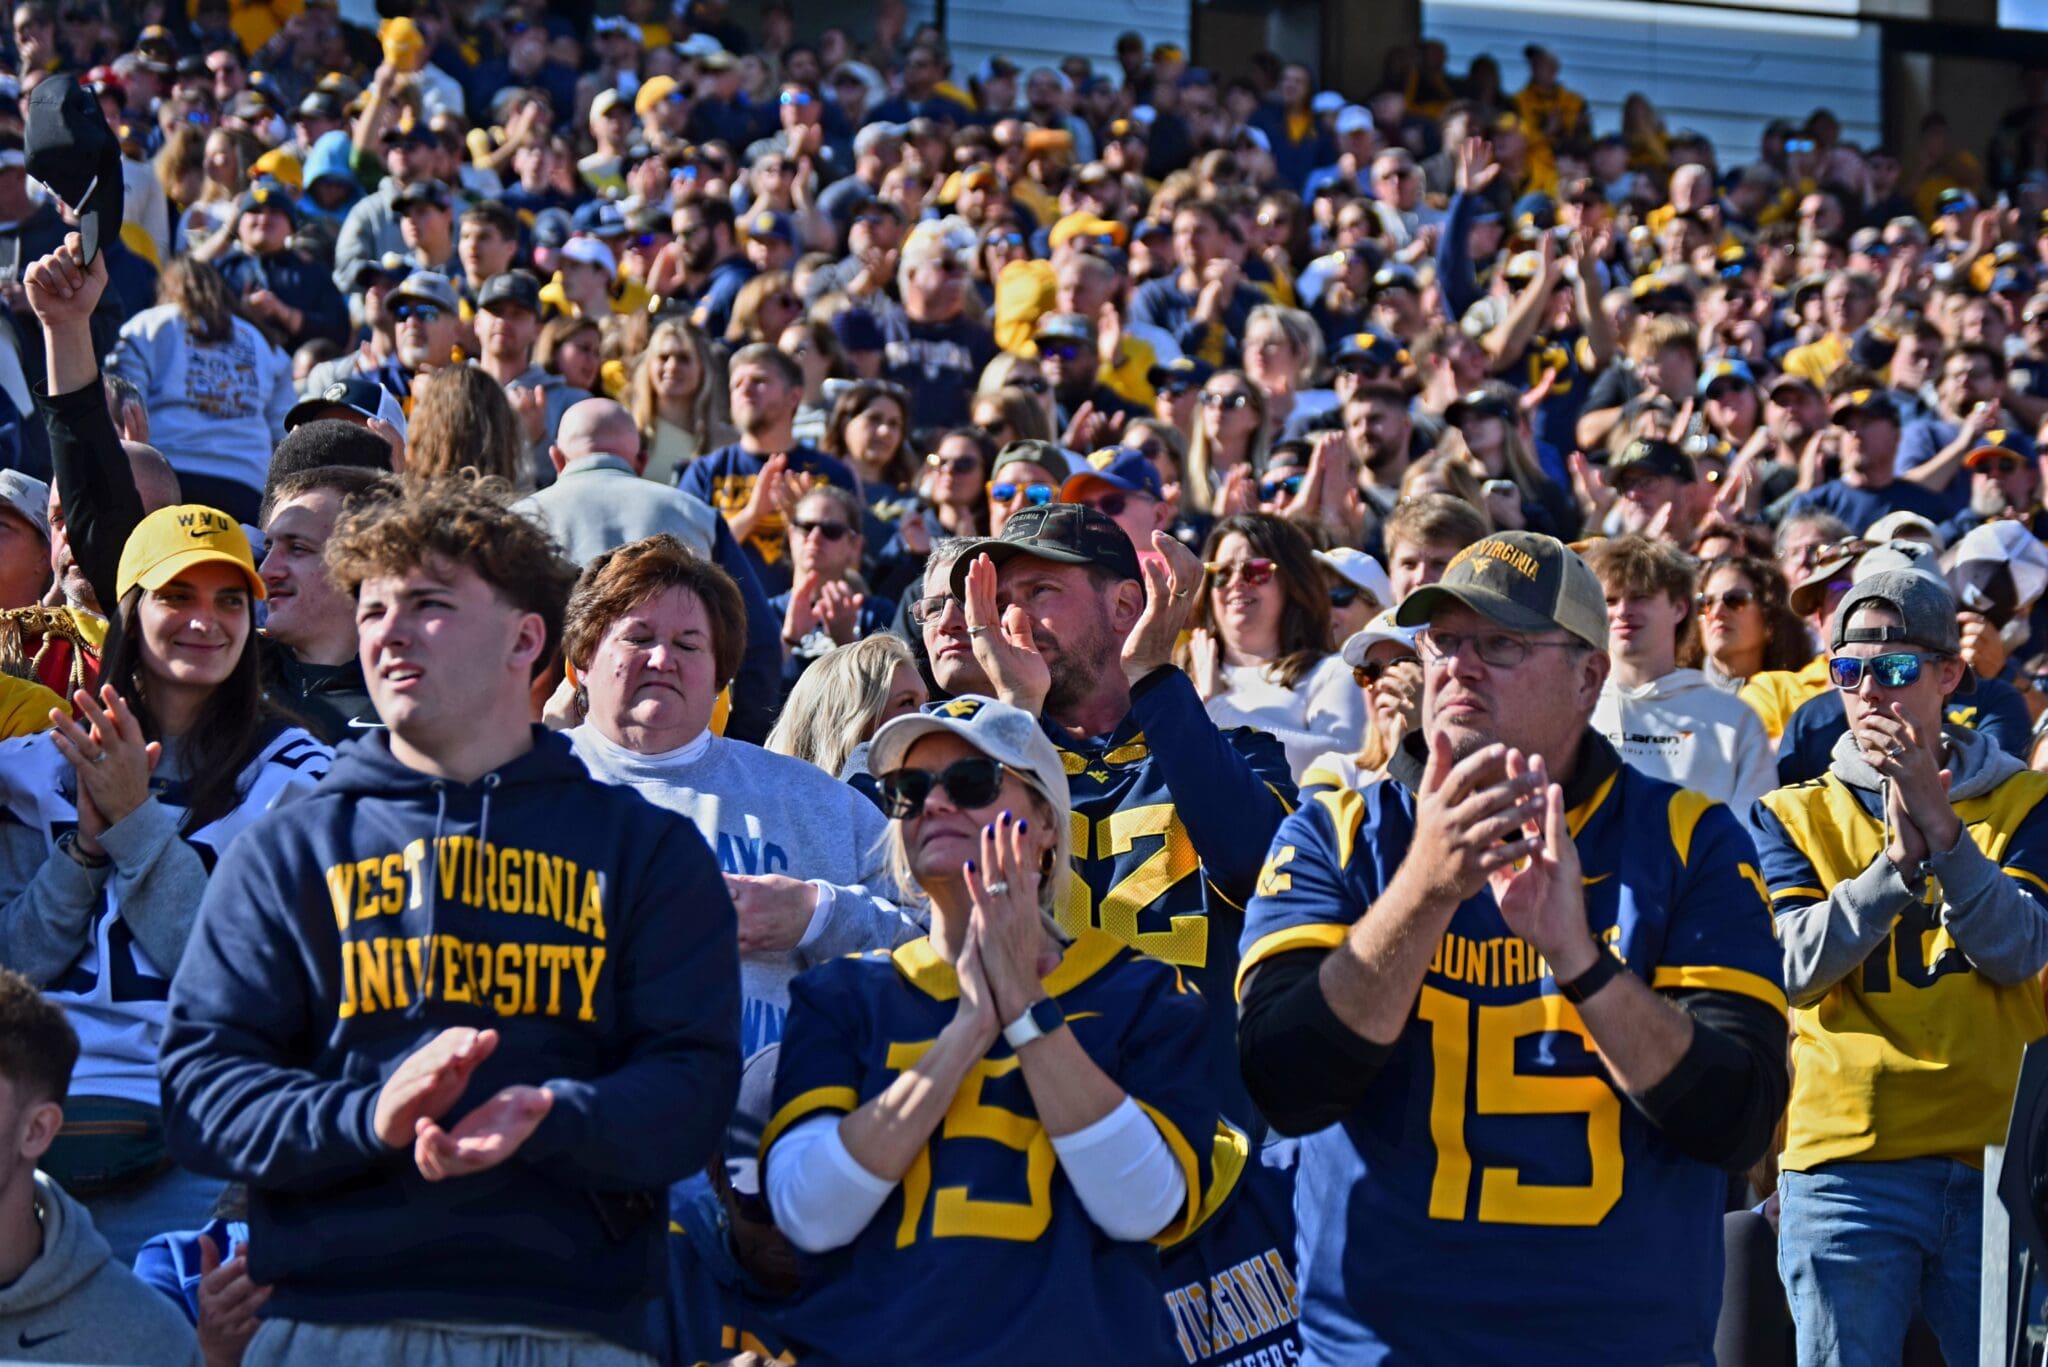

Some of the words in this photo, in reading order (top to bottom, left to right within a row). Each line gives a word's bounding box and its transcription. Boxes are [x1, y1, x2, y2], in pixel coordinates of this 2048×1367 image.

[177, 512, 229, 531] WVU
[1478, 540, 1540, 582] VIRGINIA
[432, 835, 607, 941] VIRGINIA
[338, 934, 607, 1022] UNIVERSITY
[885, 1039, 1057, 1250] 15
[1418, 984, 1625, 1226] 15
